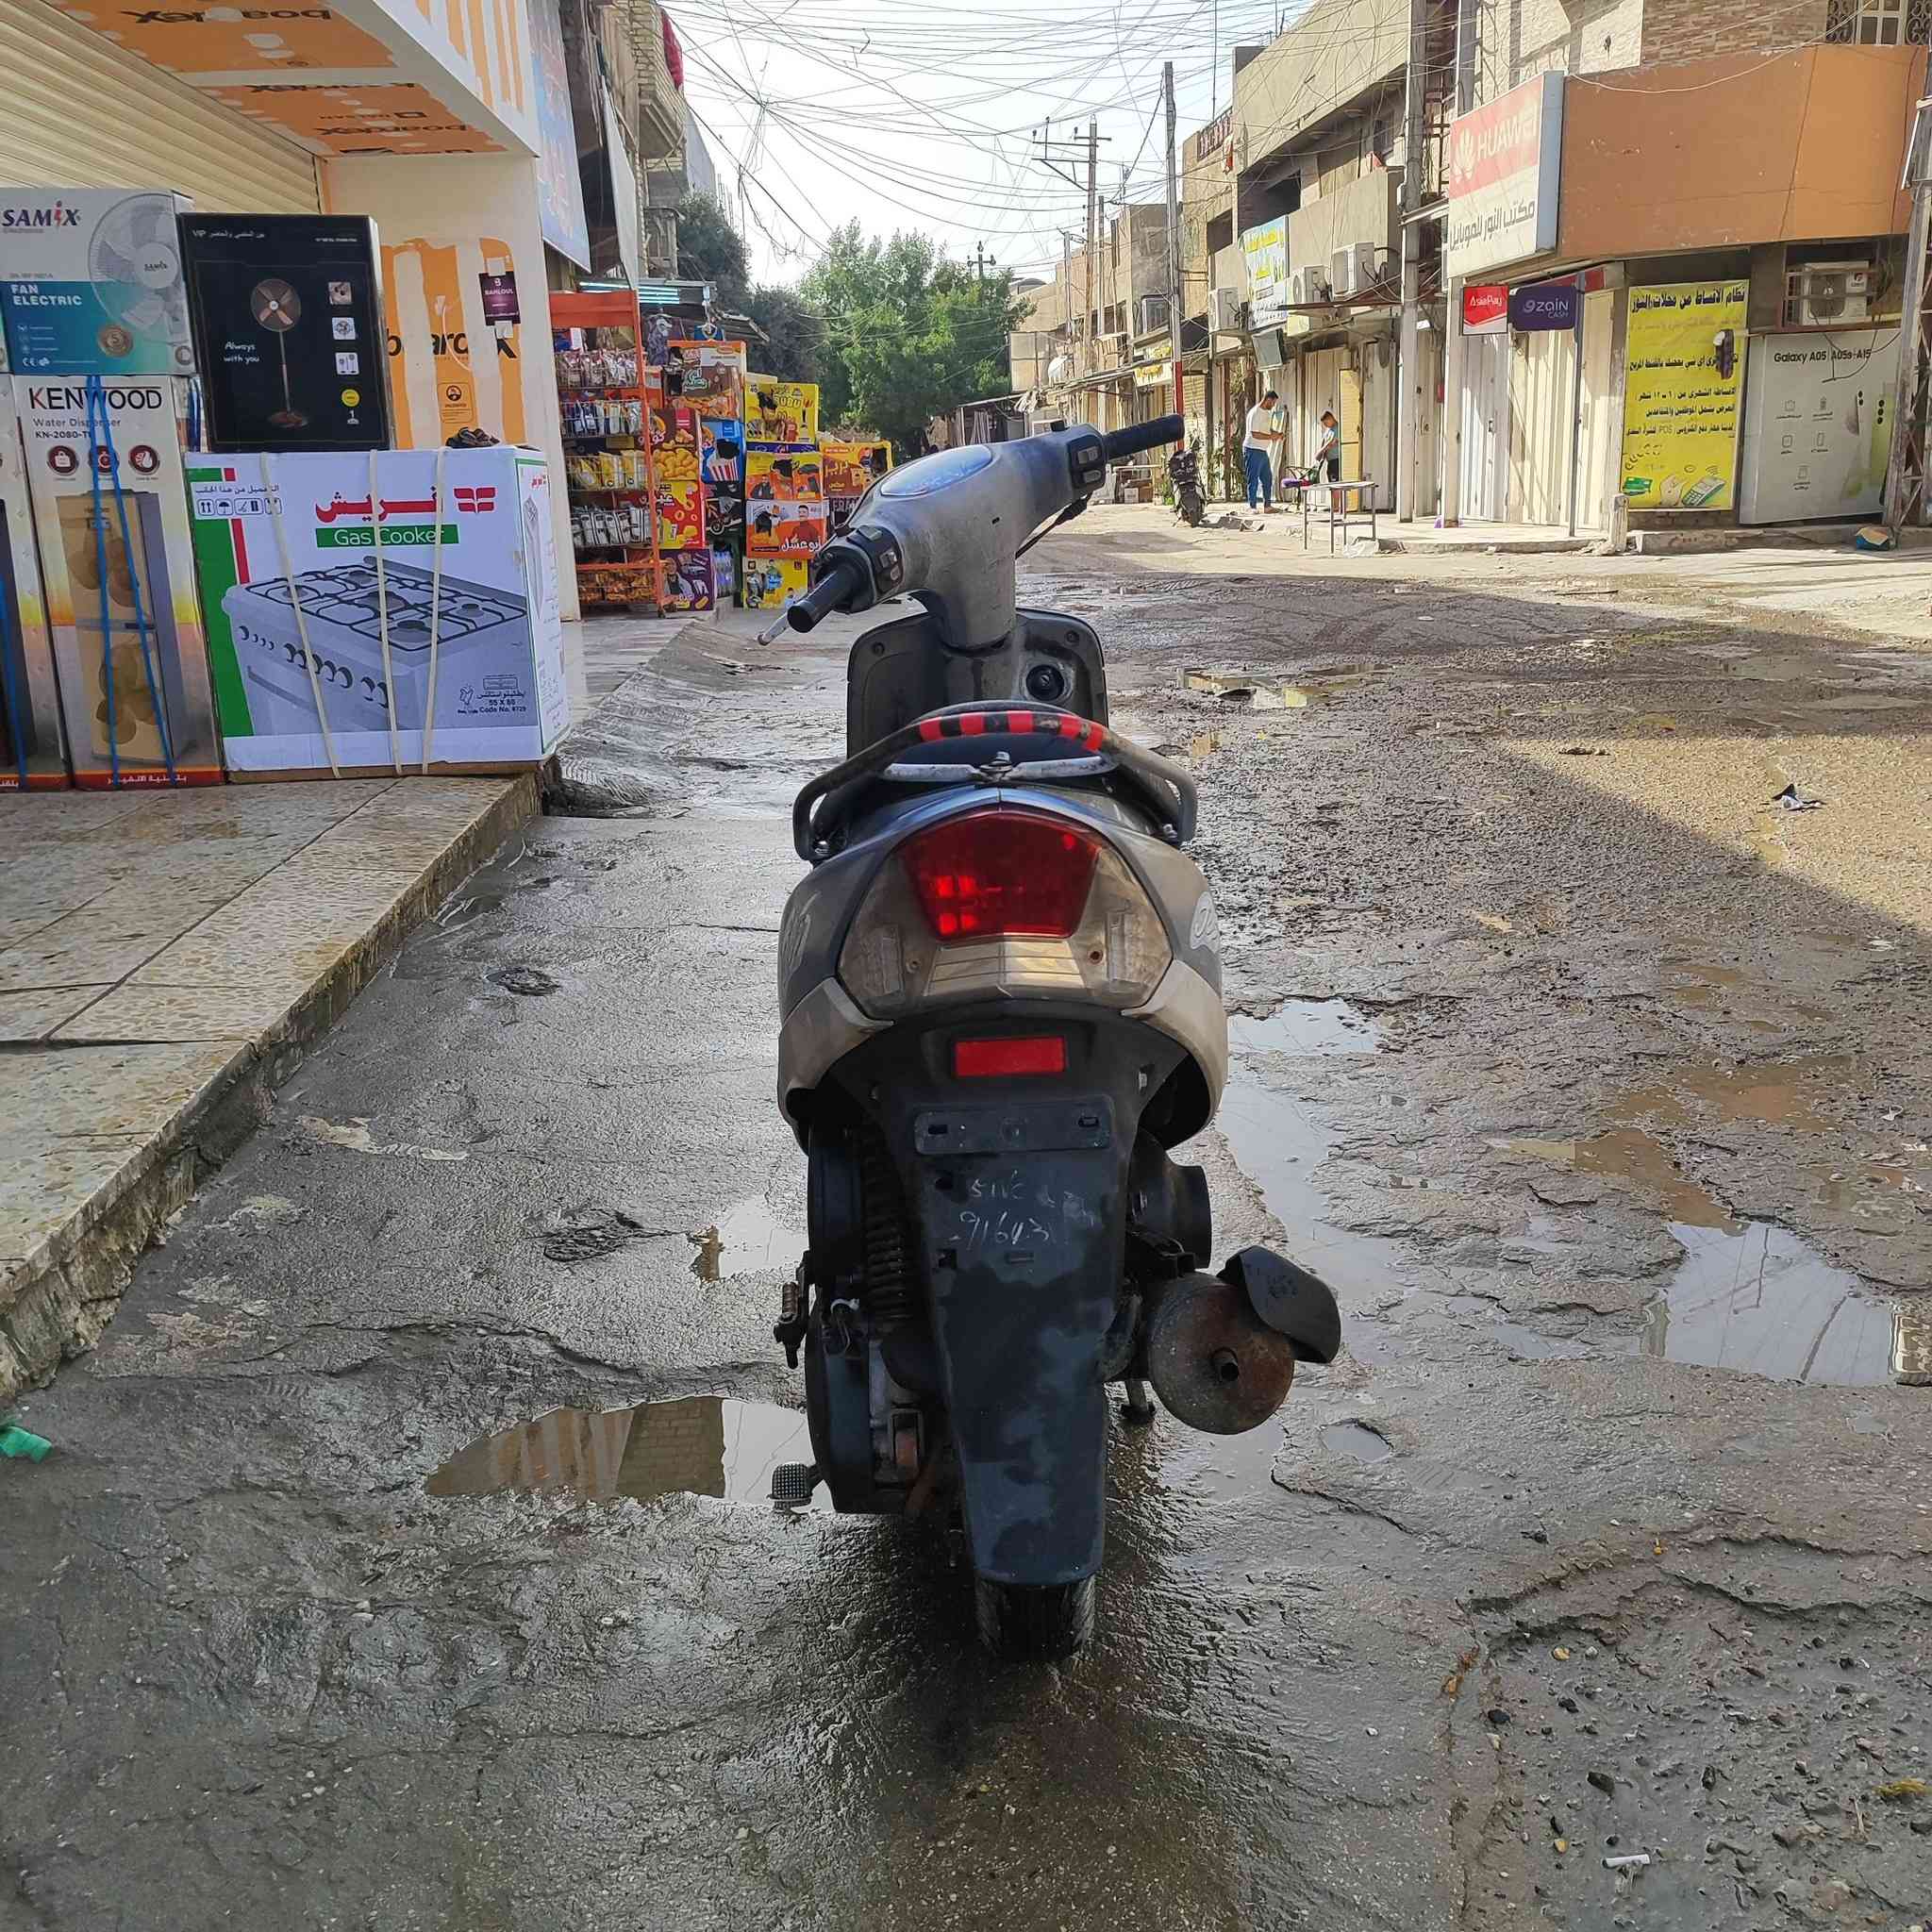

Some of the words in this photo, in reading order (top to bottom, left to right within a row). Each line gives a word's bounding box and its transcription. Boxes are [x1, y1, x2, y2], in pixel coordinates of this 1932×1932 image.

[1504, 198, 1536, 233] مكتب
[1484, 207, 1503, 242] النور
[11, 284, 39, 294] FAN
[13, 295, 83, 306] ELECTRIC
[225, 341, 256, 352] Always
[224, 354, 243, 363] with
[244, 355, 259, 365] you
[1774, 352, 1807, 364] Galaxy
[1809, 350, 1827, 361] A05
[33, 418, 67, 427] Water
[69, 418, 121, 429] Dispener
[334, 528, 374, 546] Gas
